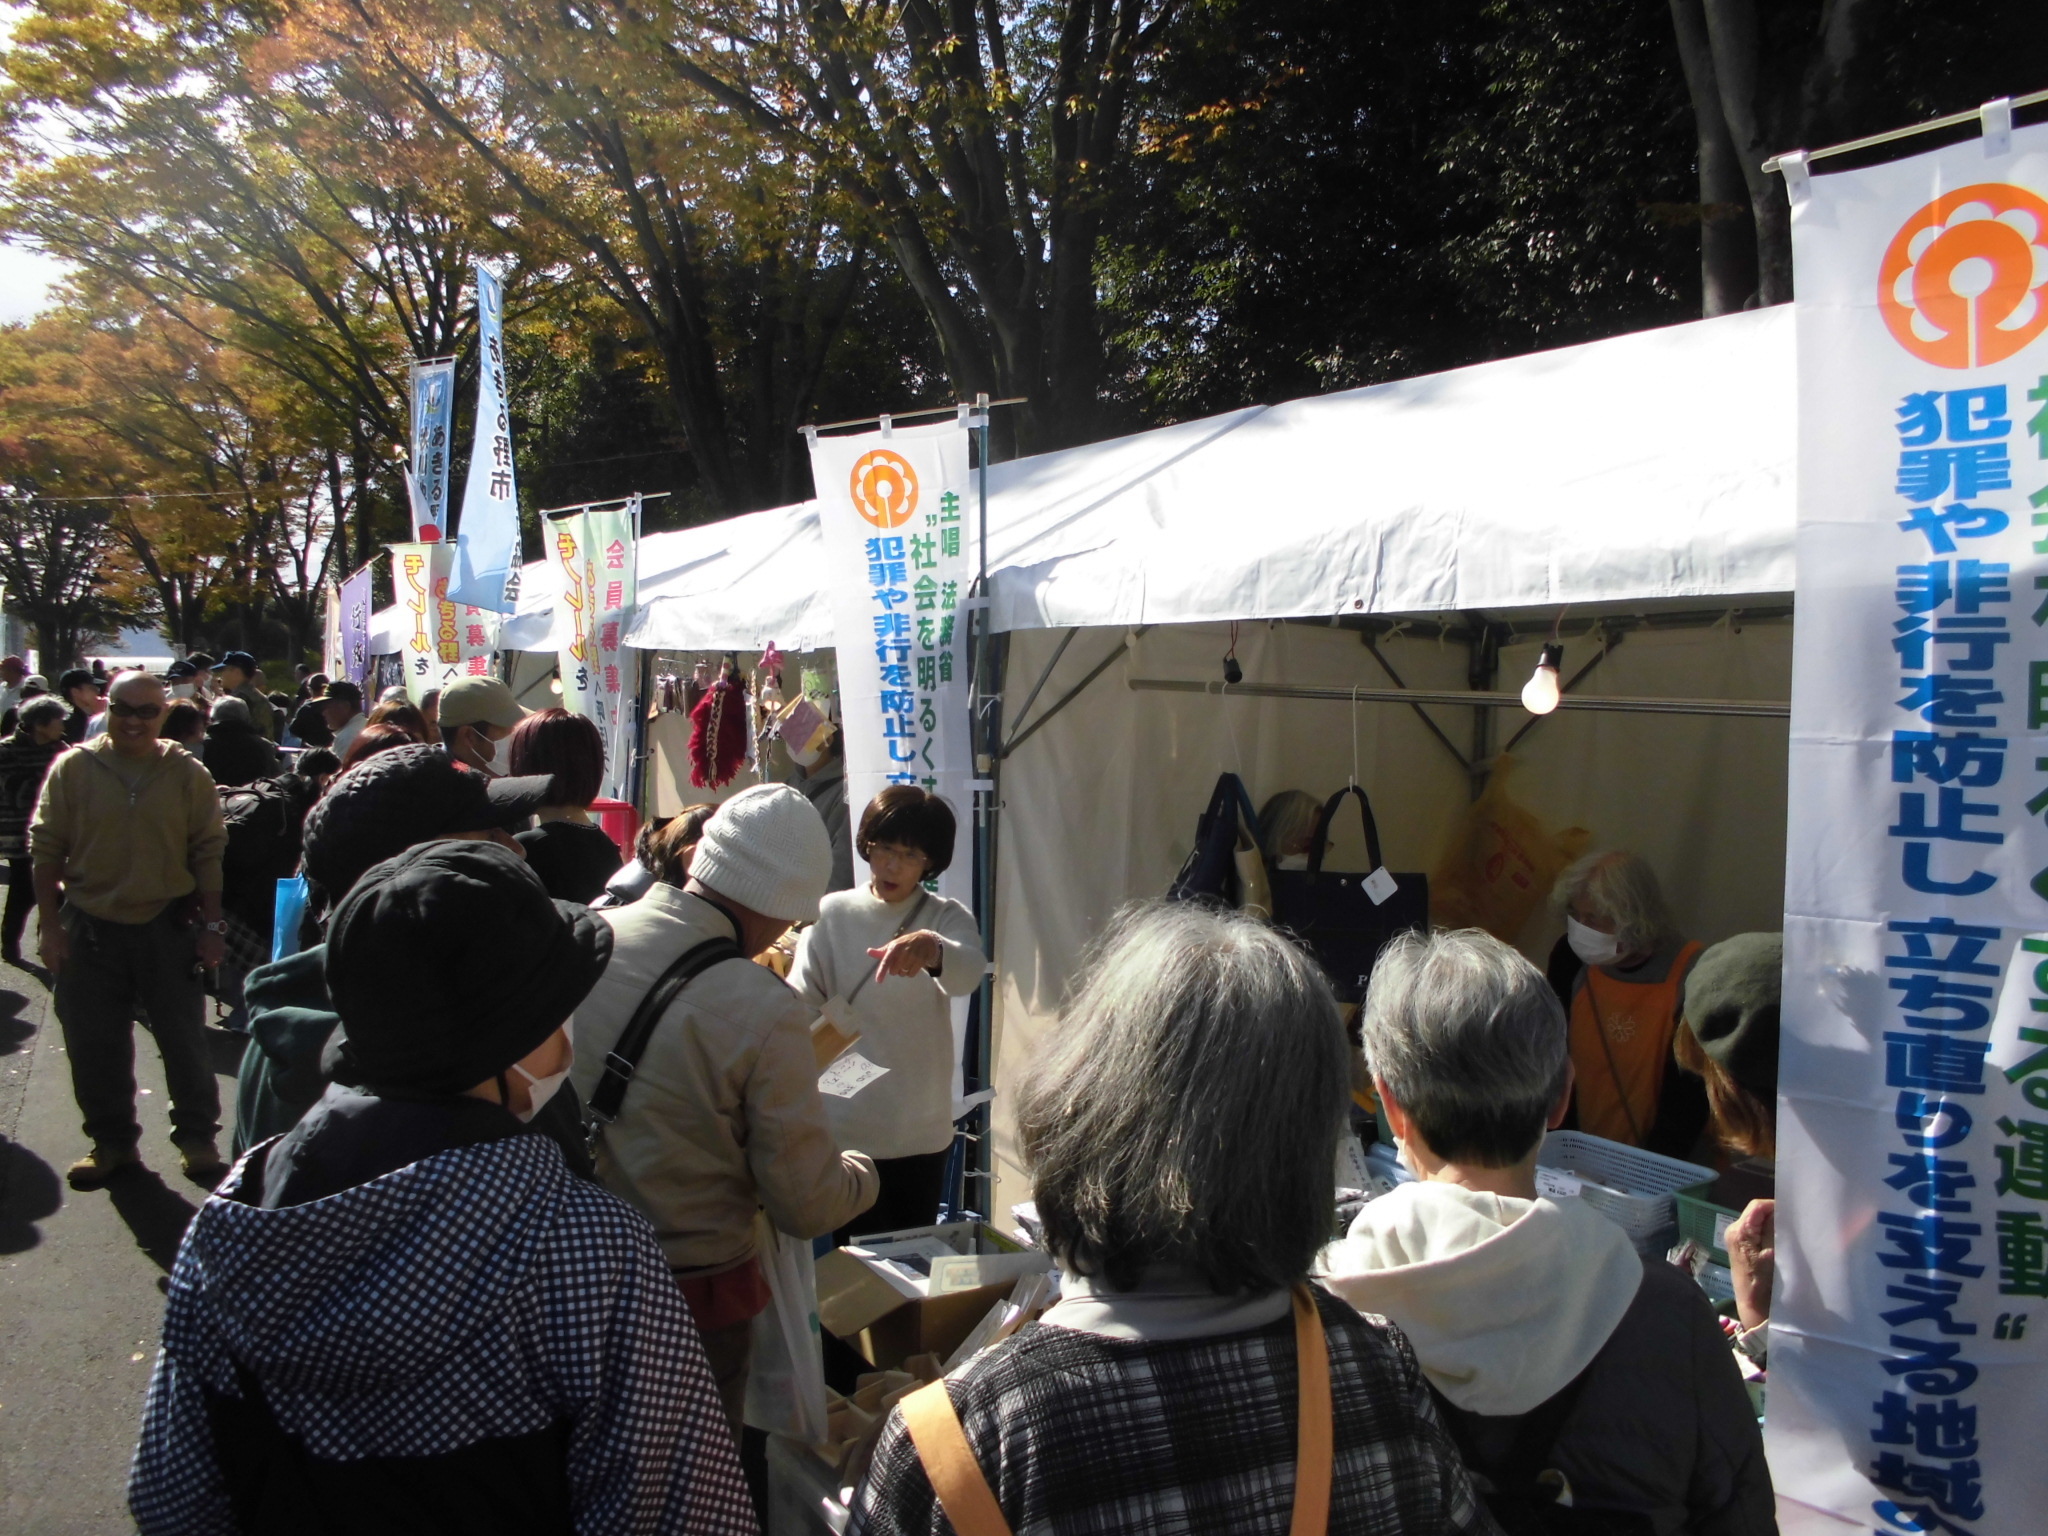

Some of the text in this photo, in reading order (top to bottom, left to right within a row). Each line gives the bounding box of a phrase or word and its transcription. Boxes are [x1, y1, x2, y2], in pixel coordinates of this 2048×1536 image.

[939, 491, 961, 682] 主唱 法務省
